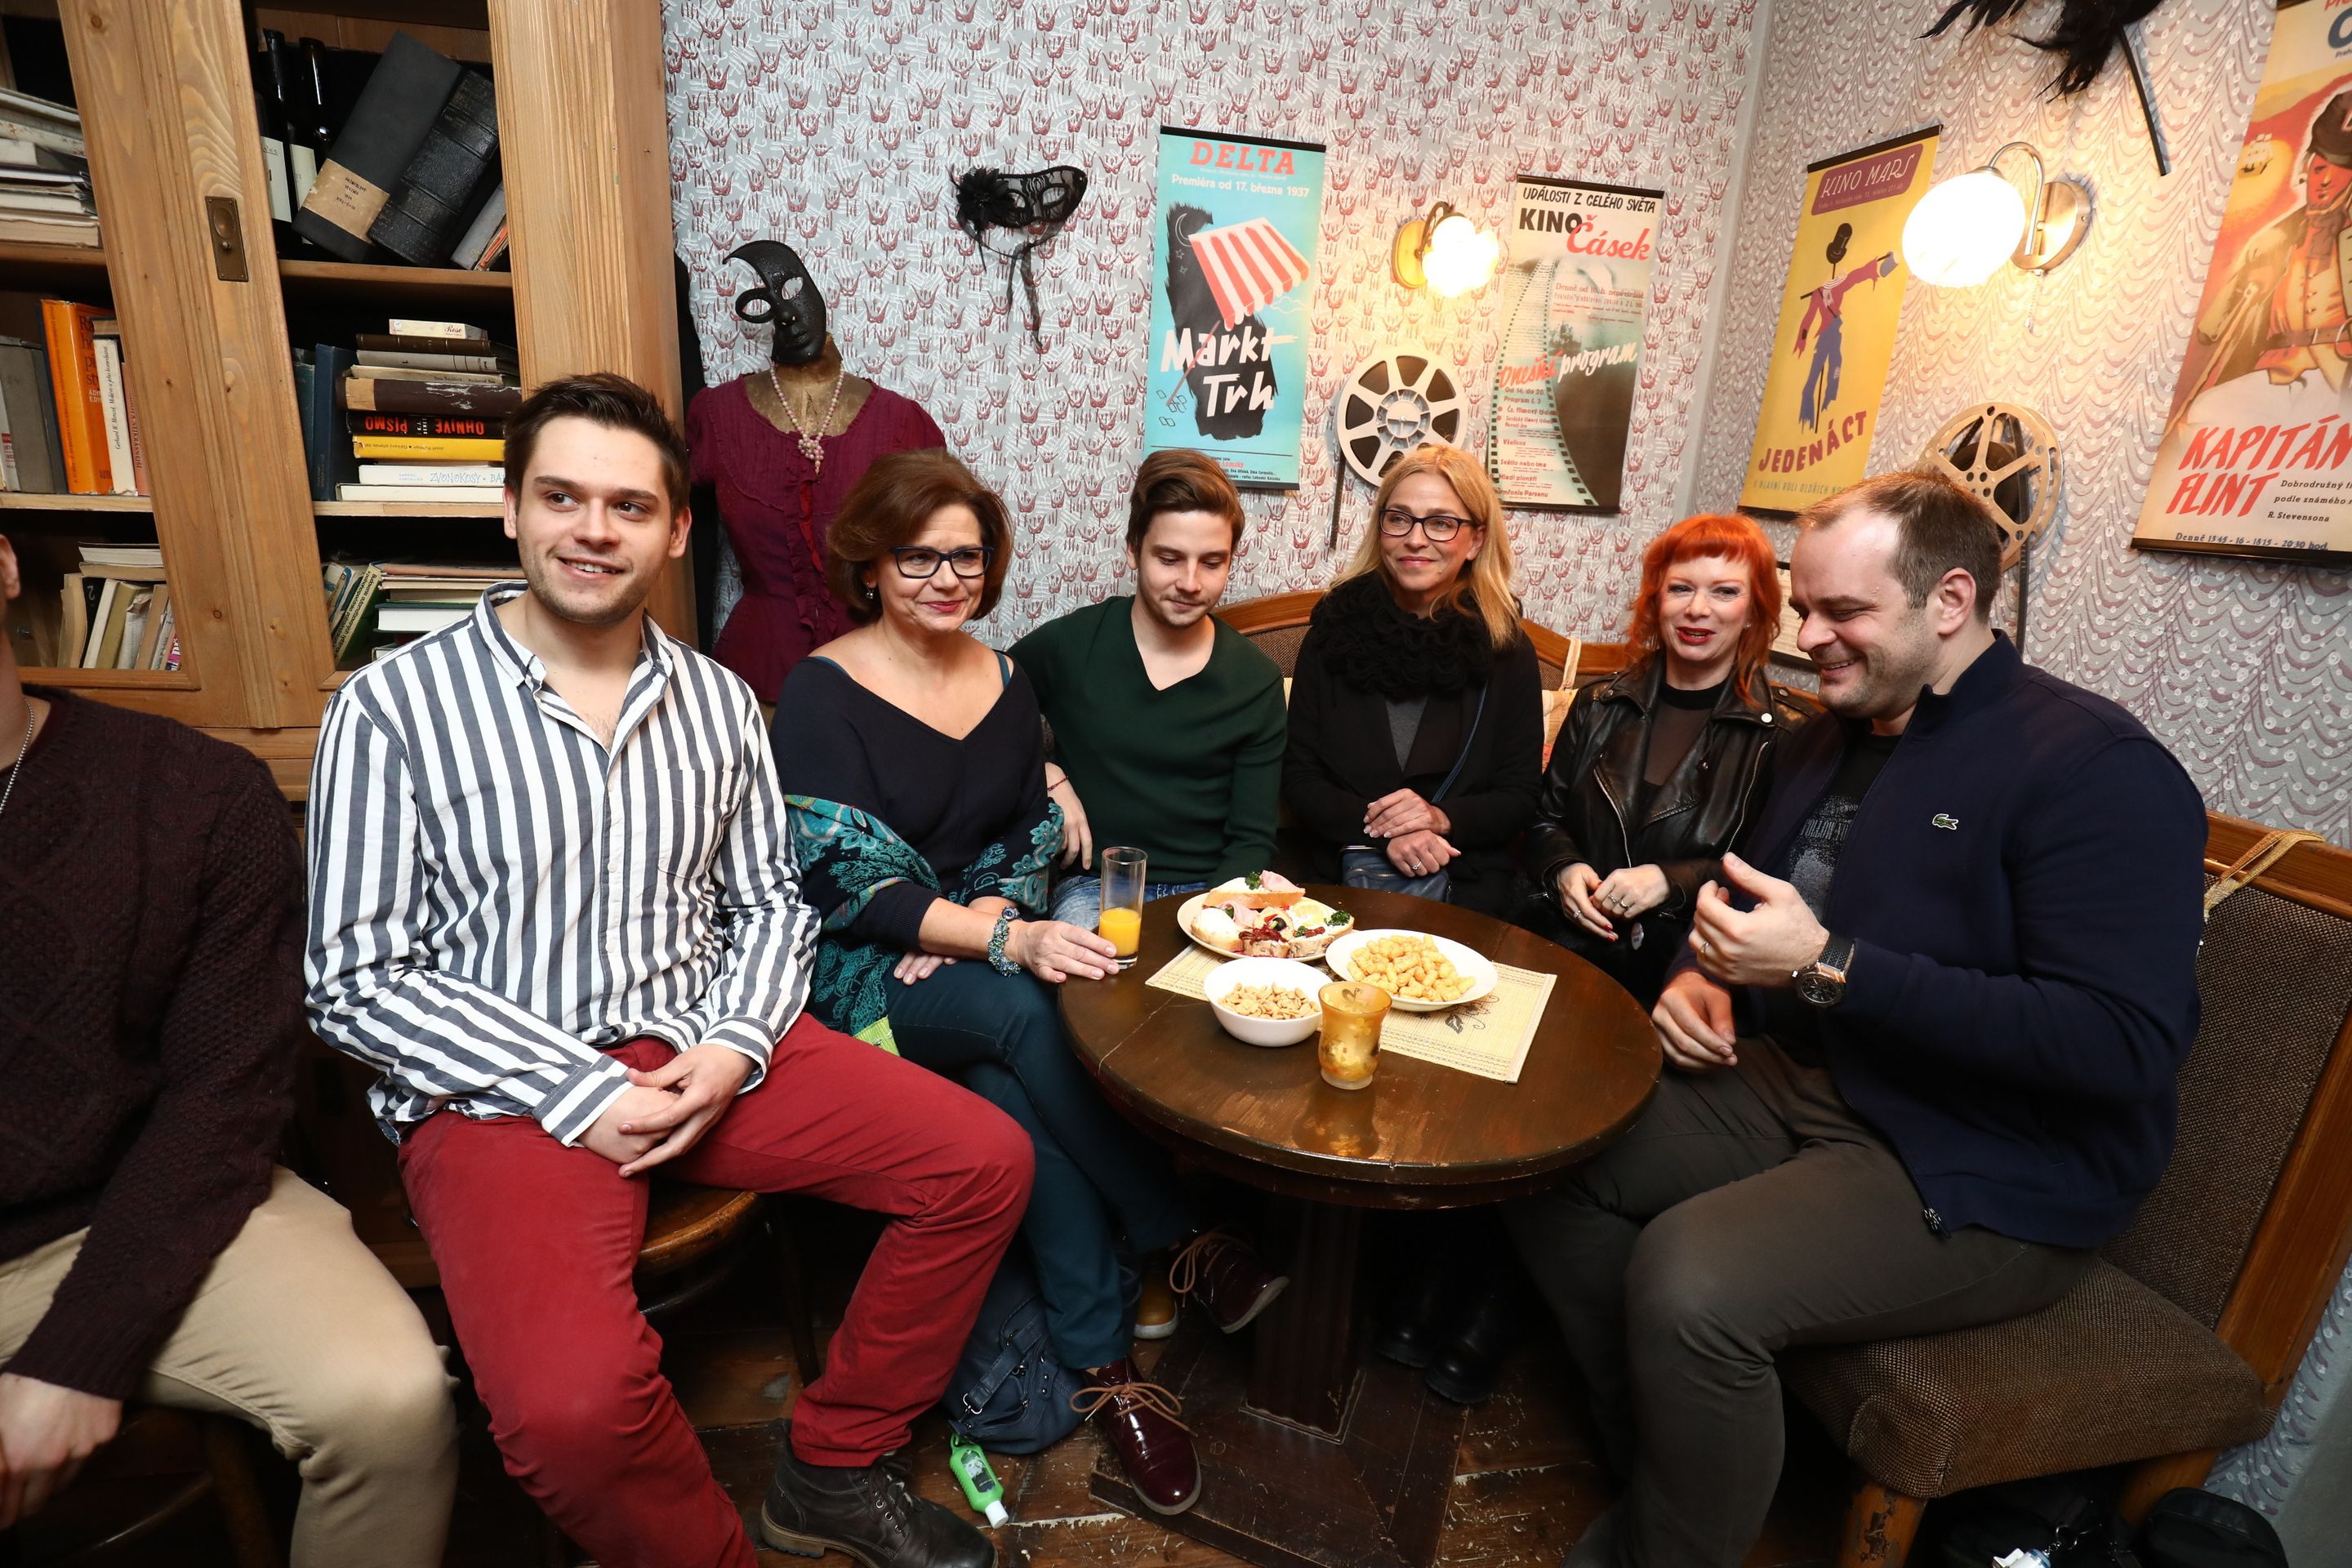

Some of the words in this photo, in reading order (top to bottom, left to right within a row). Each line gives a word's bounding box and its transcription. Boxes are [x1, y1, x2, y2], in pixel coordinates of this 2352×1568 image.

[1189, 141, 1294, 175] DELTA
[1172, 173, 1215, 188] Premiéra
[1218, 180, 1232, 189] od
[1236, 181, 1248, 191] 17.
[1251, 182, 1283, 195] března
[1287, 186, 1309, 197] 1937
[1821, 170, 1862, 198] KINO
[1864, 154, 1914, 186] MARS
[1523, 186, 1570, 203] UDÁLOSTI
[1574, 193, 1583, 204] Z
[1587, 193, 1624, 209] CELÉHO
[1627, 198, 1655, 213] SVĚTA
[1519, 208, 1583, 234] KINO
[1567, 214, 1650, 261] Čásek
[1160, 327, 1299, 372] Markt
[1558, 342, 1638, 383] program
[1203, 372, 1275, 417] Trh
[1503, 395, 1530, 403] Program
[365, 416, 408, 434] PÍSMO
[436, 418, 484, 435] OHNIVÉ
[1758, 411, 1867, 473] JEDENÁCT
[2178, 413, 2352, 471] KAPITÁN
[430, 472, 481, 483] ZVONOKOSY
[2280, 479, 2343, 491] Dobrodružný
[2165, 472, 2280, 518] FLINT
[2274, 494, 2301, 504] podle
[2303, 495, 2346, 505] známého
[2267, 510, 2275, 519] R.
[2277, 511, 2330, 523] Stevensona
[2175, 532, 2206, 542] Denně
